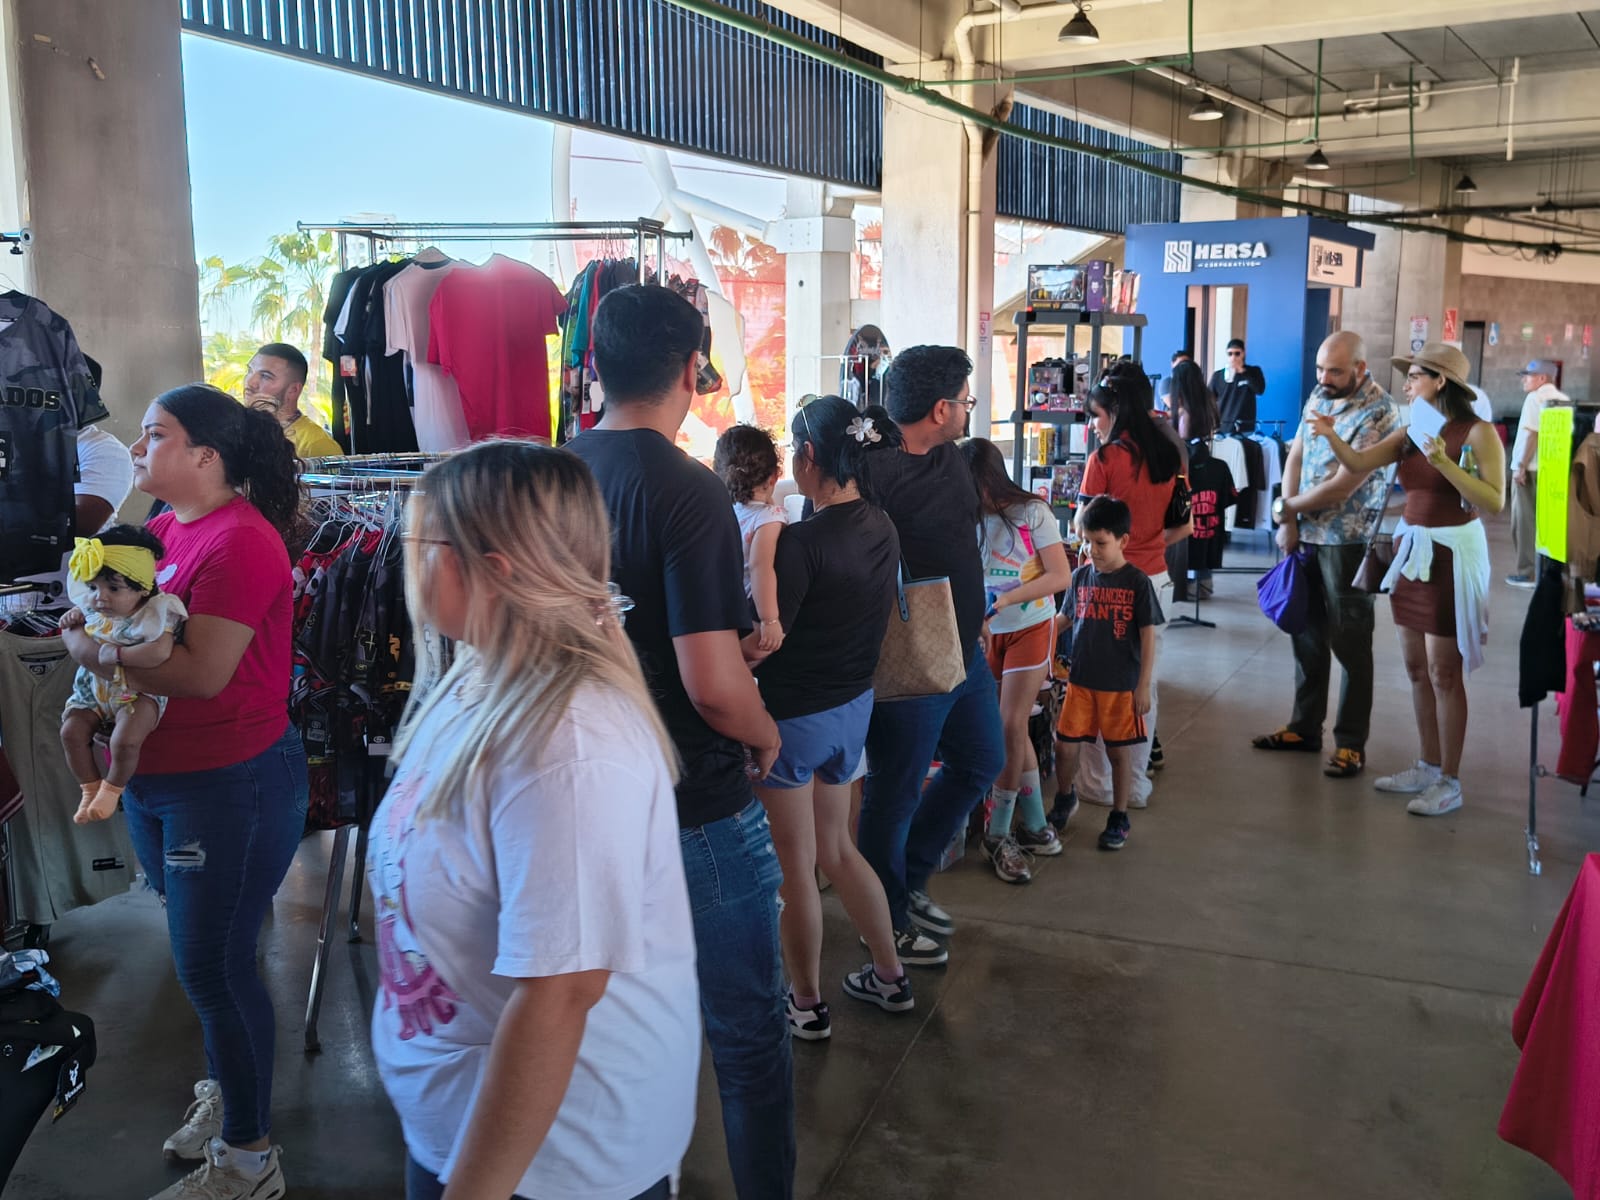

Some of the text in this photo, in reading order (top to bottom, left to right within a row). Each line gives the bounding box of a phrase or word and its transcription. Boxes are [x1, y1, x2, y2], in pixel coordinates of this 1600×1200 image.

[1194, 242, 1267, 260] HERSA
[0, 385, 61, 412] DOS
[1089, 586, 1135, 605] FRANCISCO
